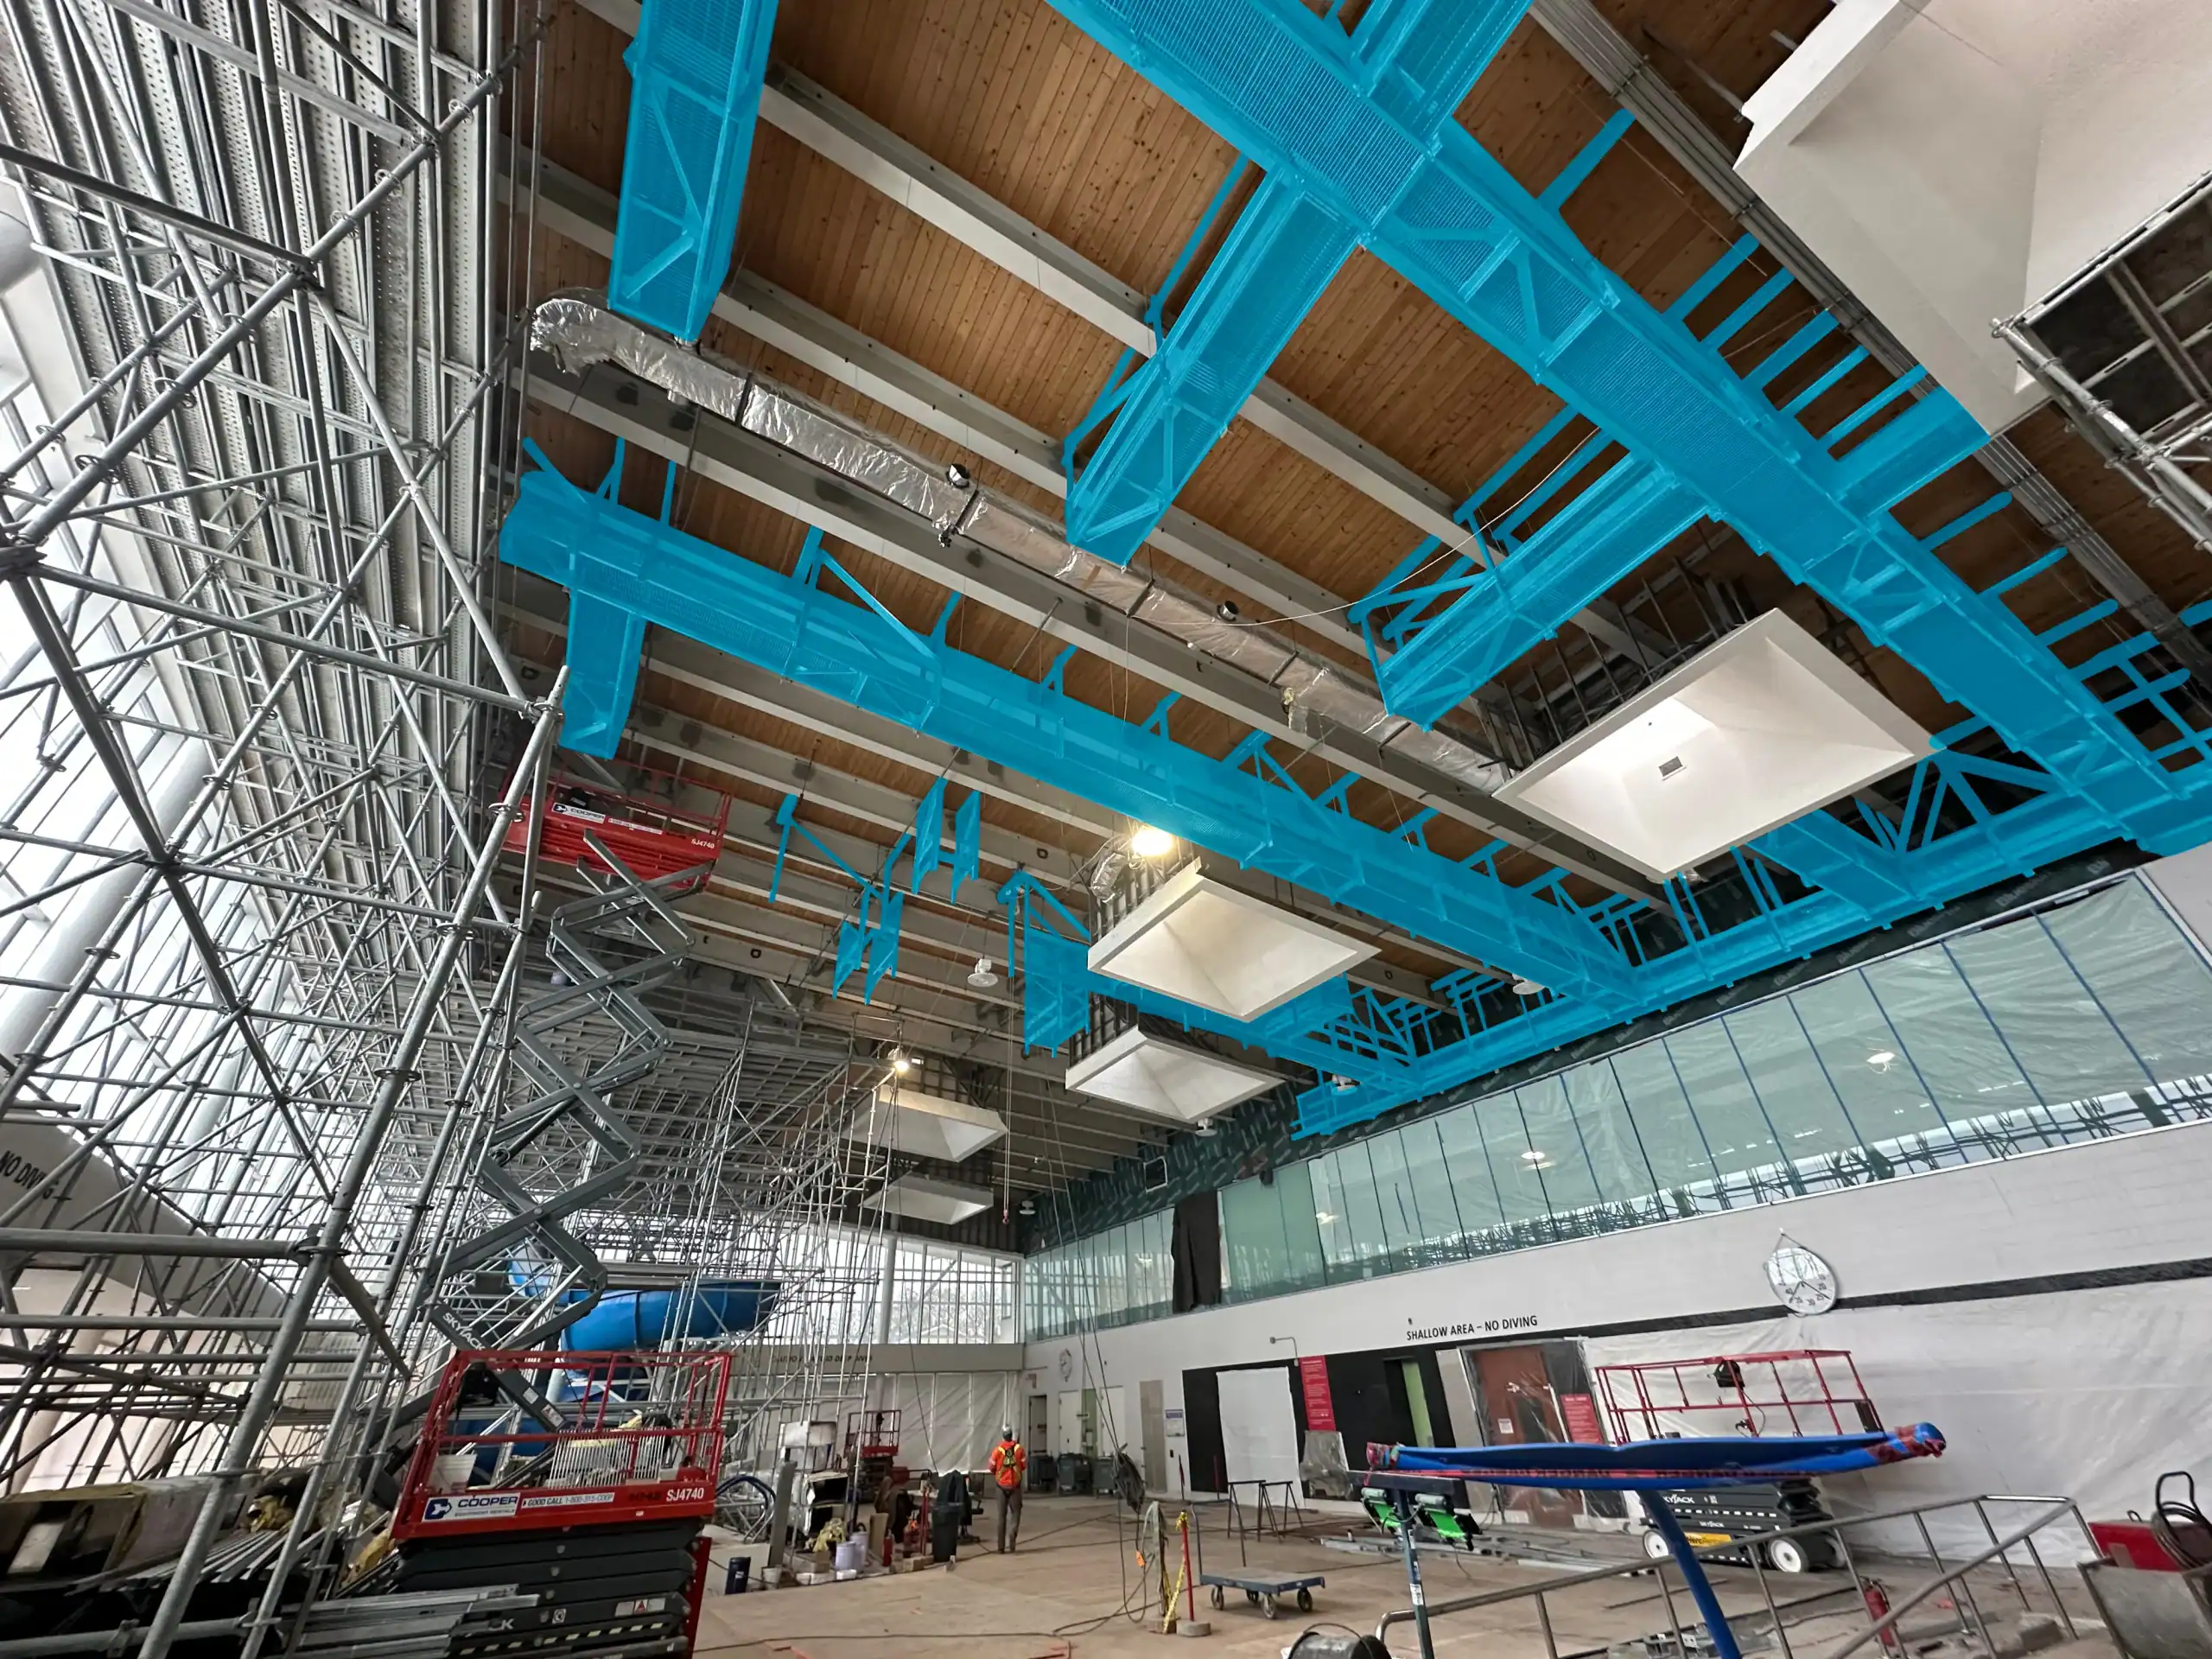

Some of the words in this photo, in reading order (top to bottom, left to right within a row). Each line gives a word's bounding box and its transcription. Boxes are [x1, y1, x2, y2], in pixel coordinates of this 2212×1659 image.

[570, 808, 605, 819] COOPER
[690, 838, 715, 849] SJ4740
[0, 1150, 22, 1177] NO
[1407, 1326, 1447, 1341] SHALLOW
[1450, 1323, 1475, 1336] AREA
[1484, 1320, 1499, 1332] NO
[1502, 1315, 1538, 1330] DIVING
[666, 1487, 704, 1502] SJ4740
[1662, 1493, 1695, 1504] KYJACK
[458, 1496, 518, 1508] COOPER
[527, 1498, 546, 1507] GOOD
[546, 1497, 563, 1506] CALL
